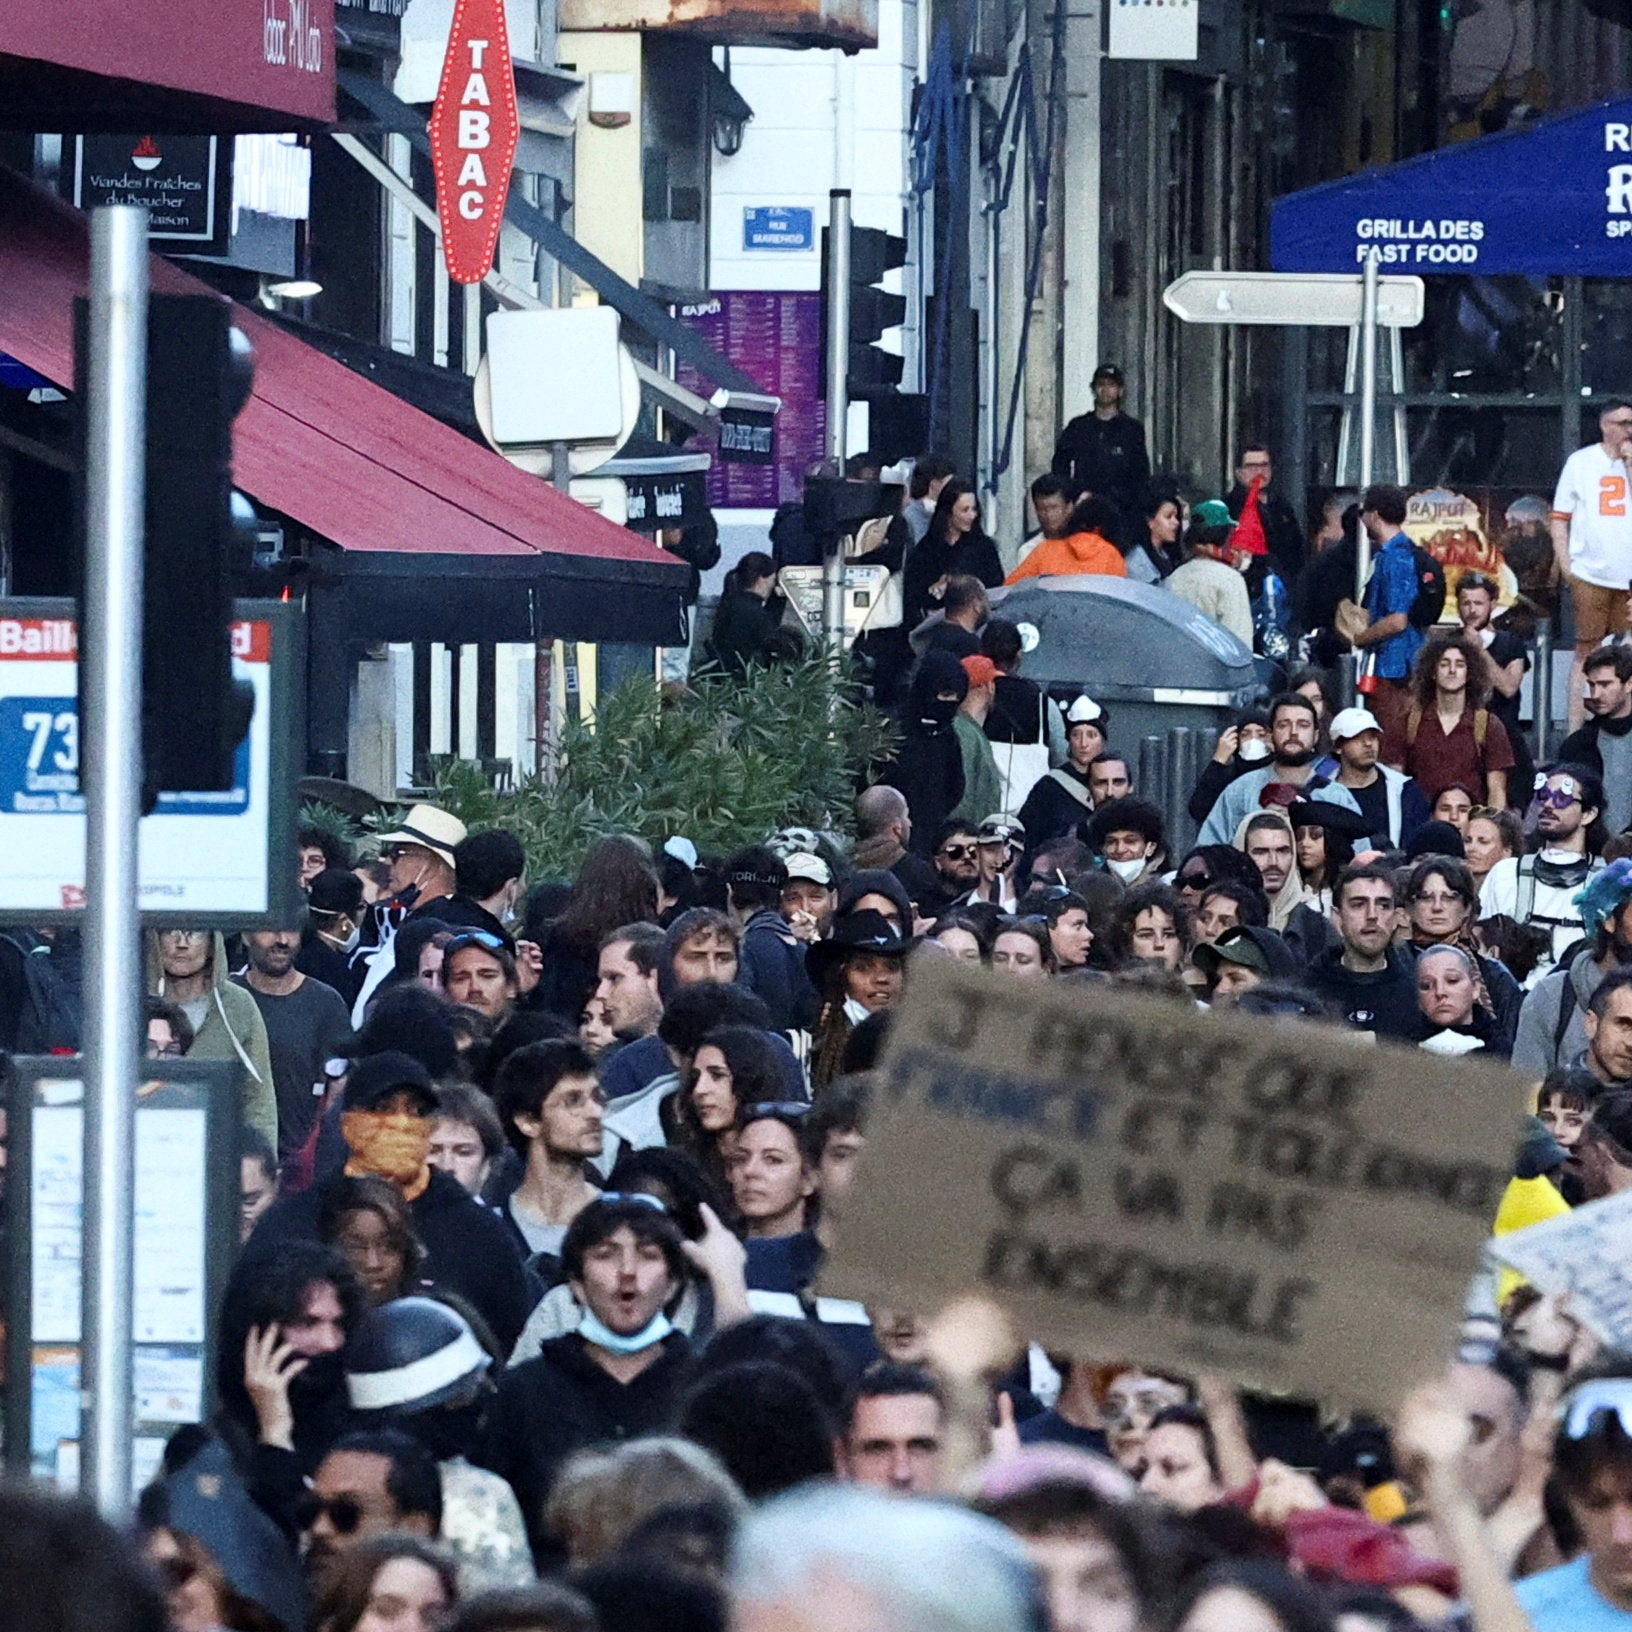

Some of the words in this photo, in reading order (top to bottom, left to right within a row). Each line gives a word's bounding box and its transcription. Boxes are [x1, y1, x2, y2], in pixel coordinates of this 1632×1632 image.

[457, 39, 491, 220] TABAC
[90, 171, 141, 189] Viandes
[145, 174, 201, 190] Fraîches
[105, 189, 125, 205] du
[127, 191, 185, 207] Boucher
[768, 220, 788, 231] RUE
[1356, 218, 1485, 240] GRILLADES
[1356, 243, 1411, 264] FAST
[1415, 243, 1478, 263] FOOD
[1599, 475, 1626, 517] 2
[1409, 502, 1466, 521] RAJPUT
[22, 711, 79, 772] 73
[1204, 1178, 1325, 1252] PAS
[981, 1231, 1317, 1344] ENSEMBLE
